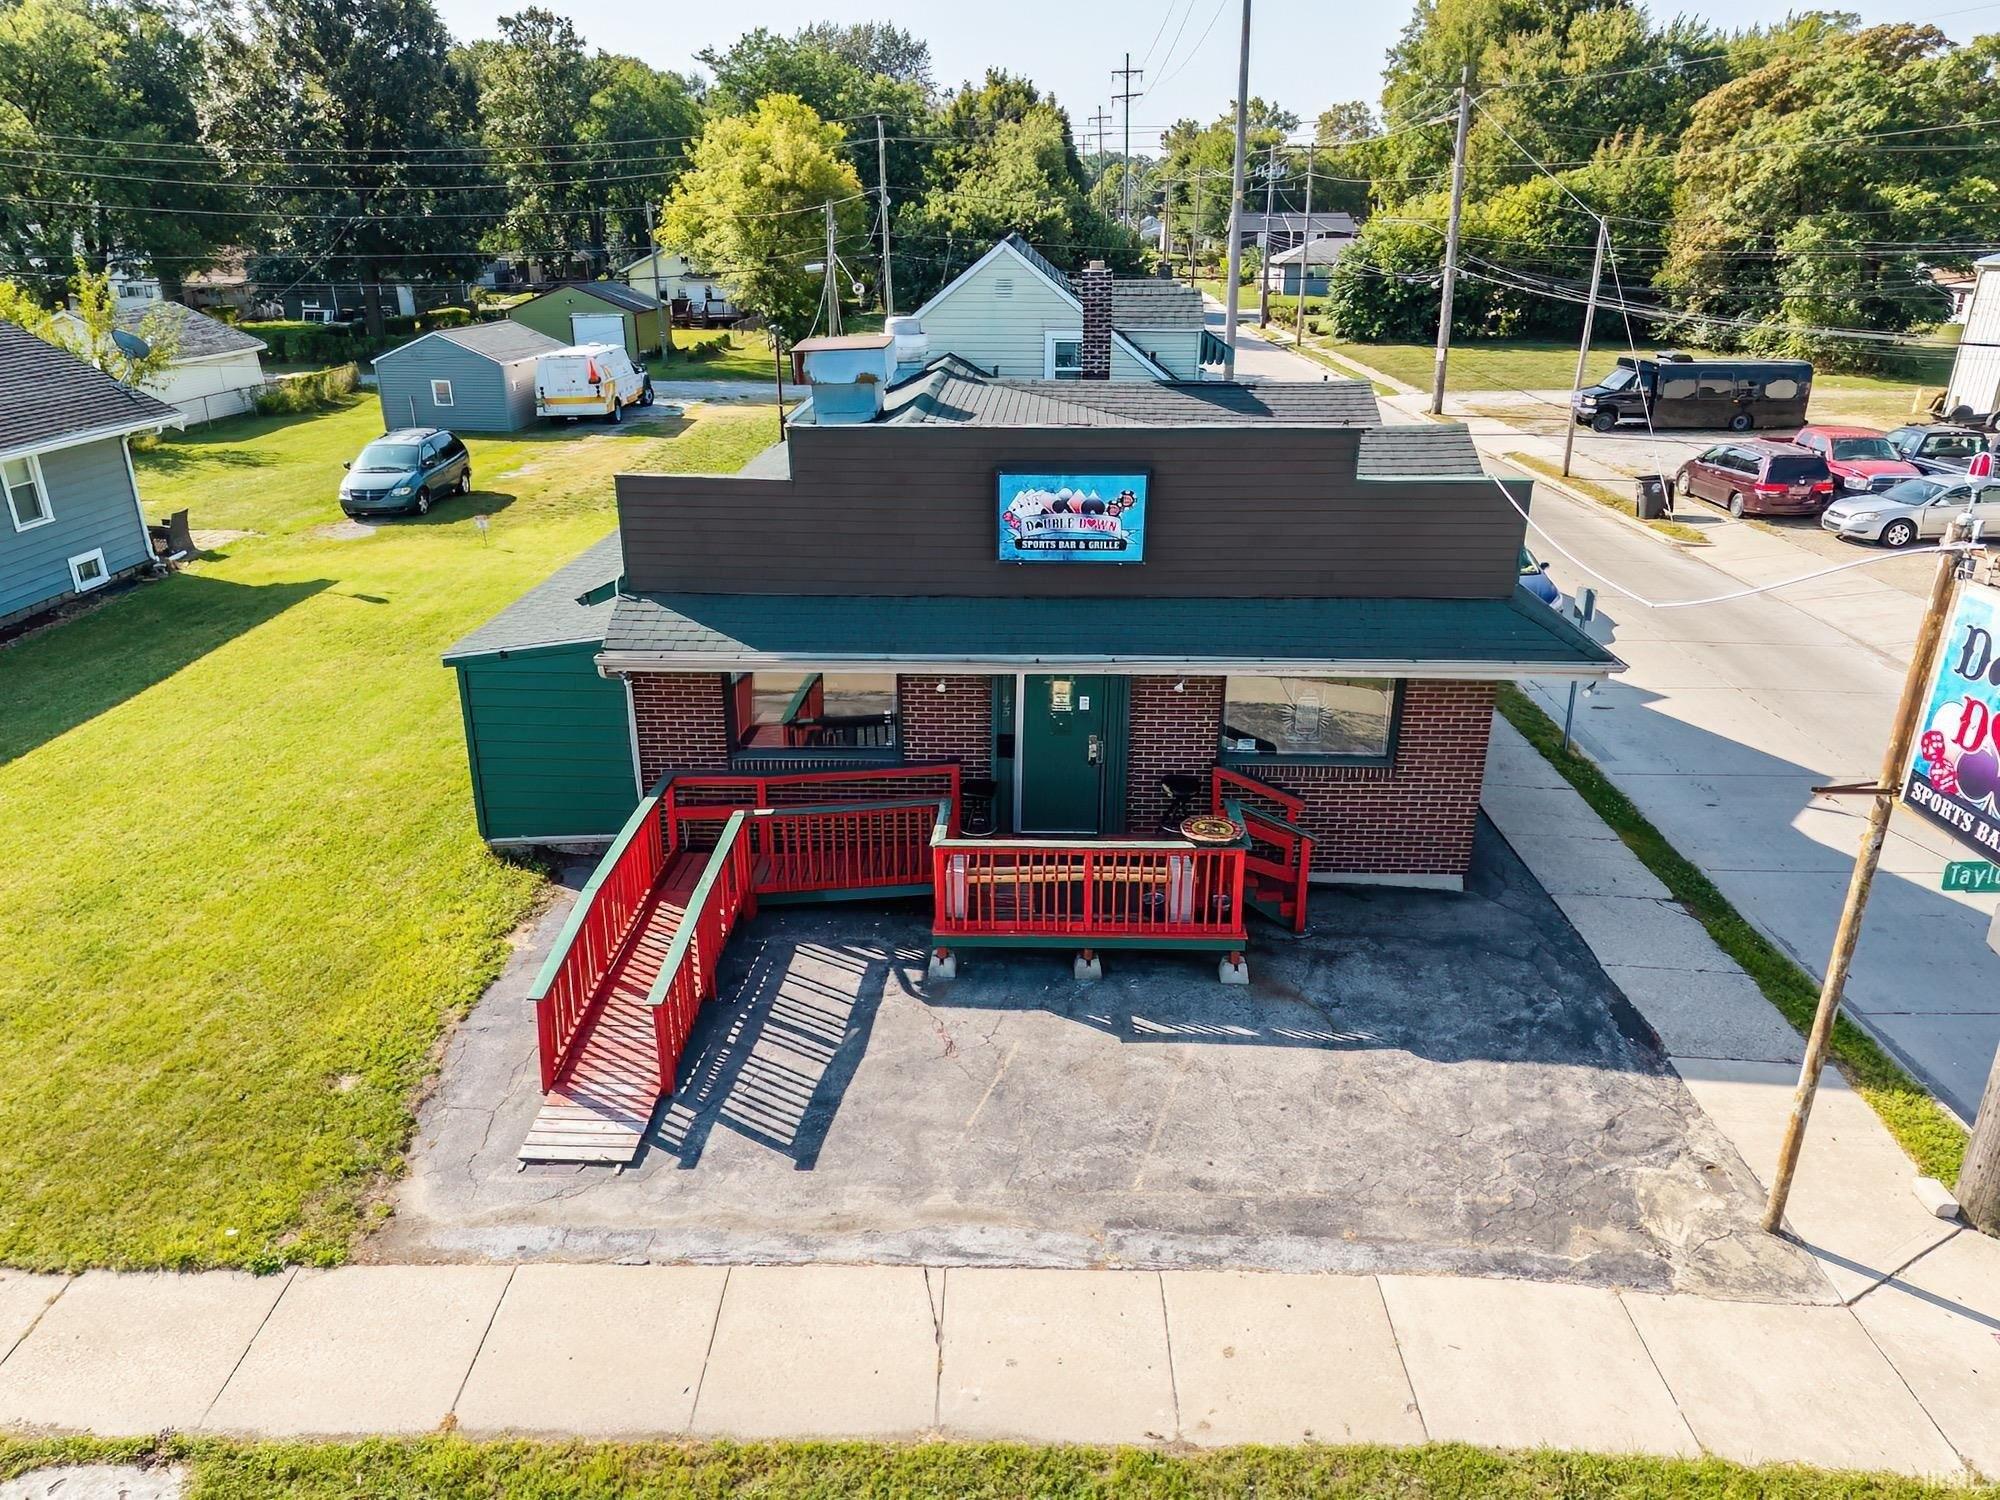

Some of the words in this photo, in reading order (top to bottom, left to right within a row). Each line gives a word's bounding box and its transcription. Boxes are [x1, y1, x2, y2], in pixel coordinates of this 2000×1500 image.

[1022, 540, 1056, 549] SPORTS
[1059, 540, 1076, 549] BAR
[1079, 540, 1086, 549] &
[1088, 540, 1120, 549] GRILLE
[1911, 781, 1975, 832] SPORTS
[1974, 821, 2000, 853] BA
